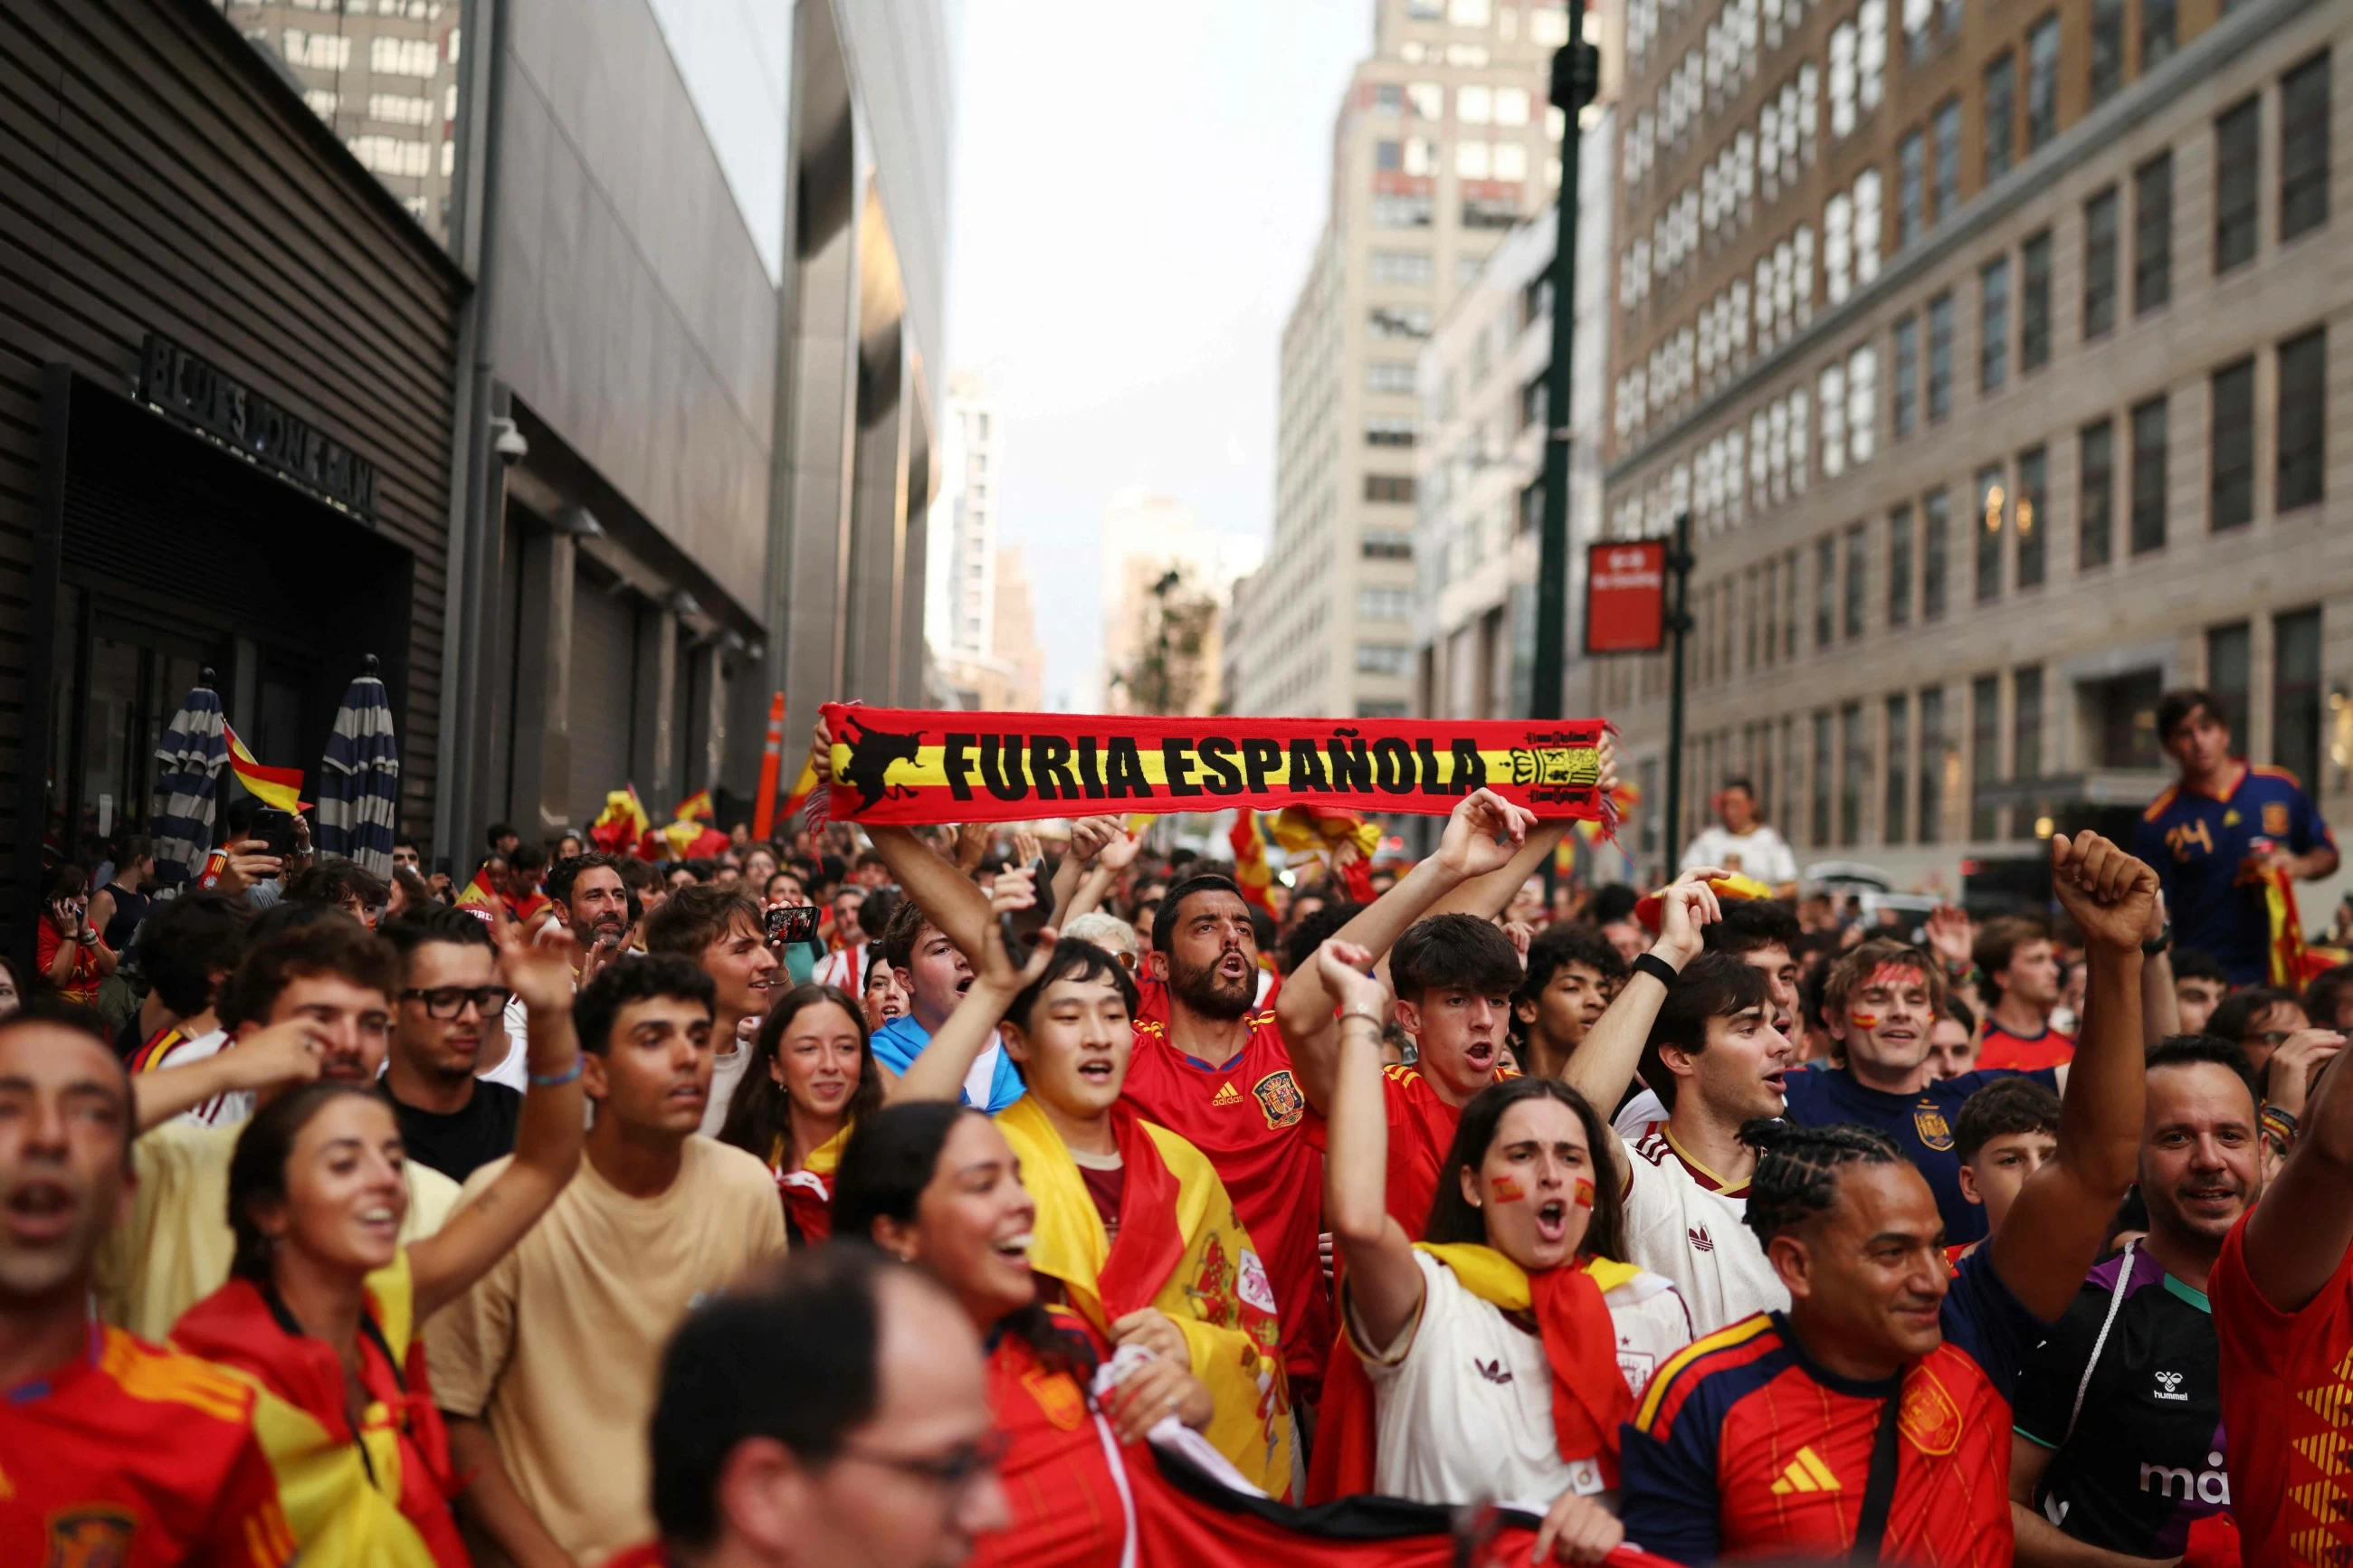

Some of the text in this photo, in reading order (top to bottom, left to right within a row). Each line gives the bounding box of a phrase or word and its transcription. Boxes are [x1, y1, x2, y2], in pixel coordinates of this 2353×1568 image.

[943, 727, 1487, 801] FURIA ESPAÑOLA
[2165, 817, 2215, 862] 24
[1213, 1095, 1243, 1106] adidas
[2153, 1390, 2188, 1401] hummel
